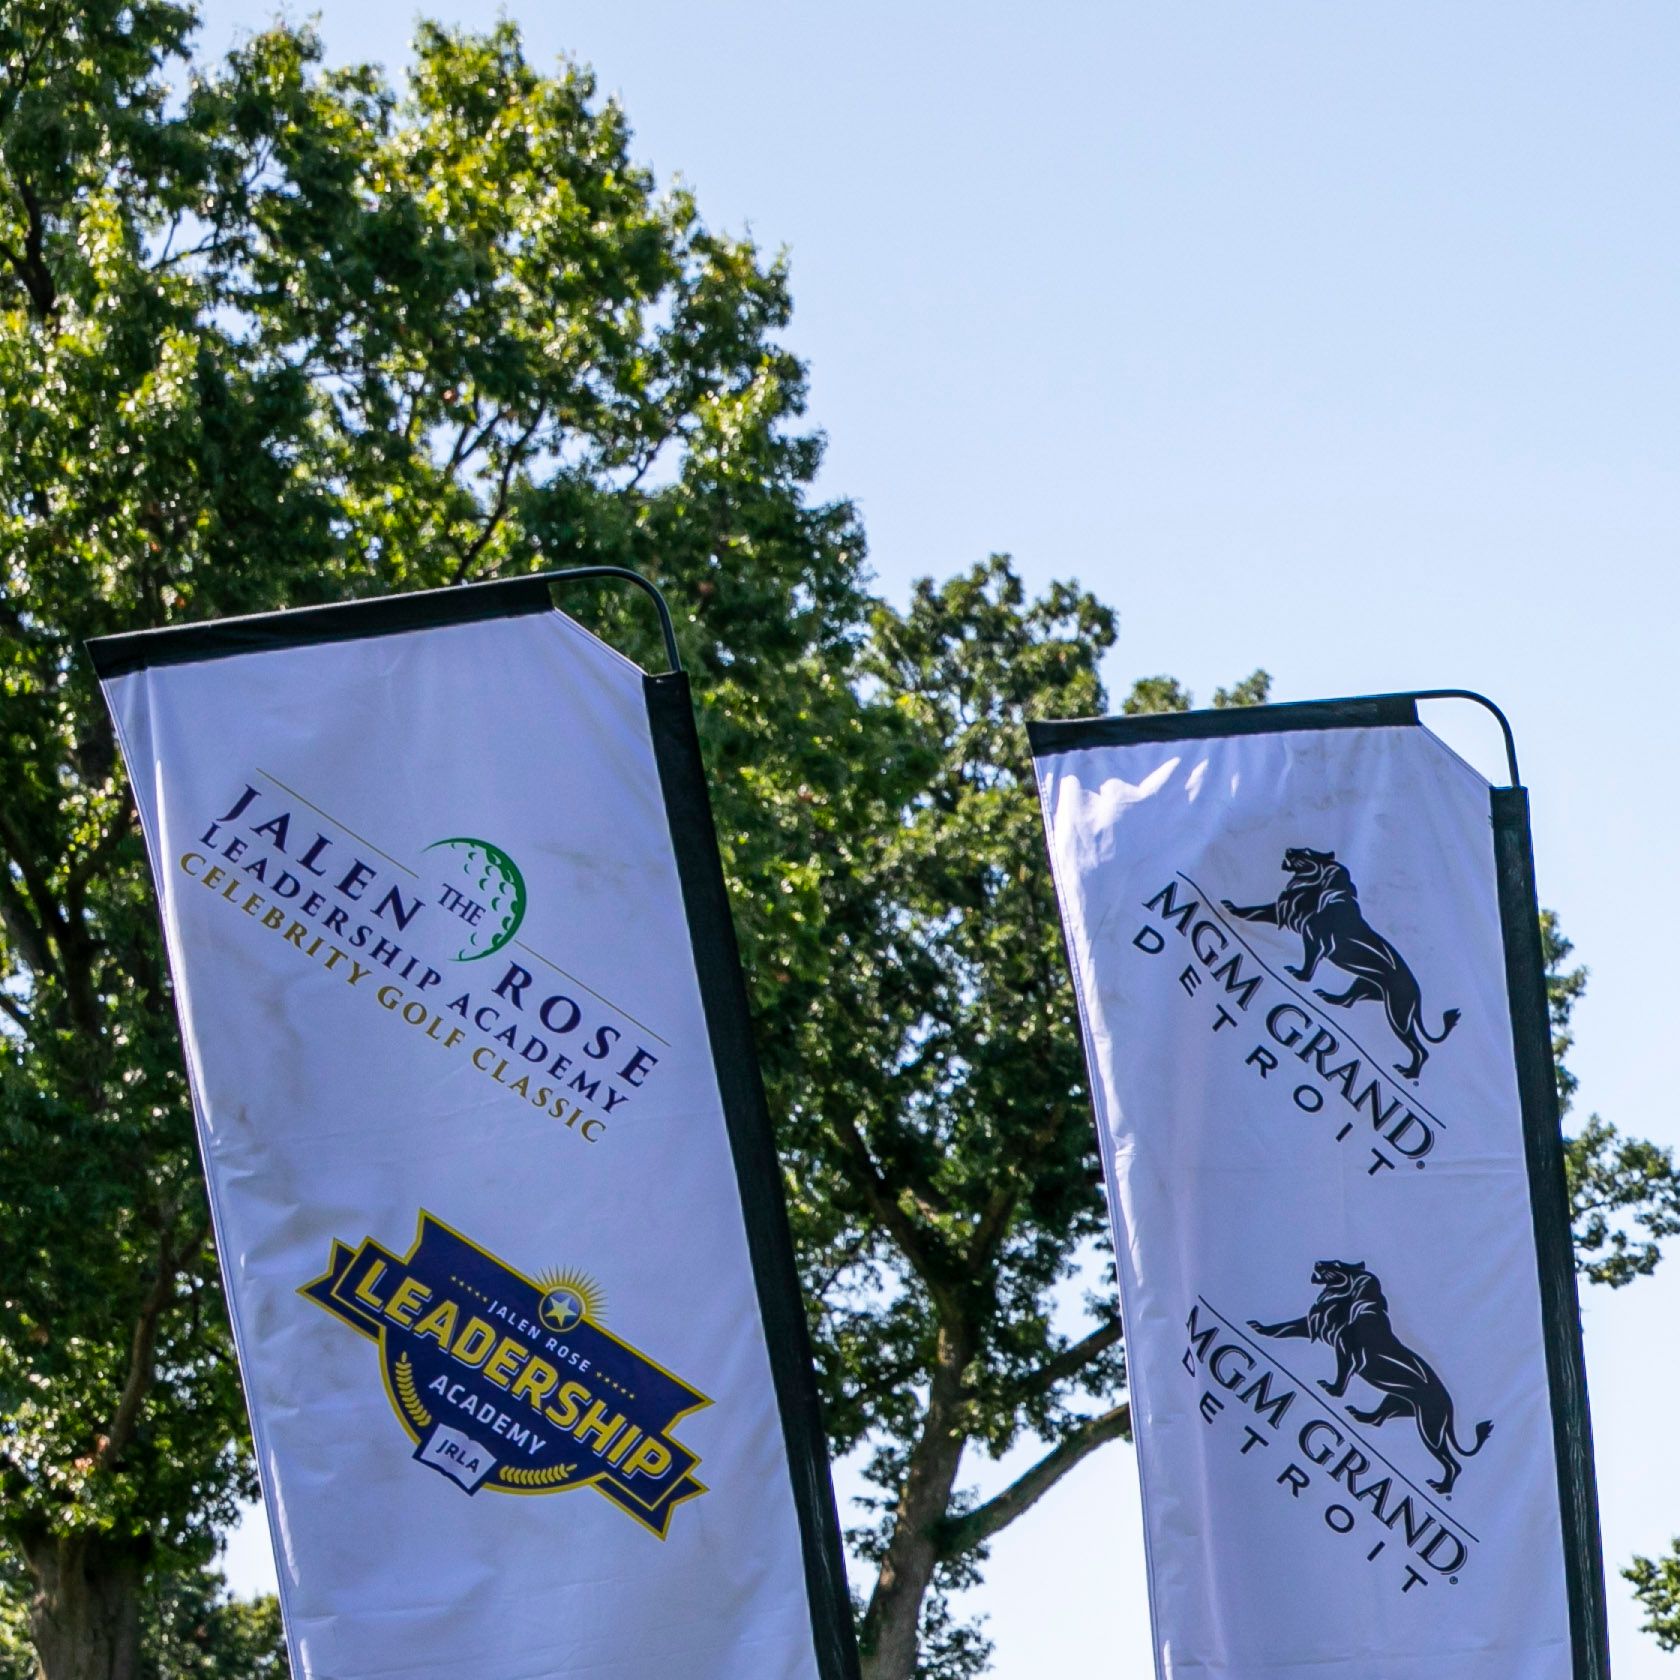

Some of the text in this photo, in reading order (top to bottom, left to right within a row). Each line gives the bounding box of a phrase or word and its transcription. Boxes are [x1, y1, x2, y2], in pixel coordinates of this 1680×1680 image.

[178, 851, 606, 1144] CELEBRITY GOLF CLASSIC
[199, 821, 630, 1115] LEADERSHIP ACADEMY
[215, 784, 659, 1090] JALEN THE ROSE
[1132, 924, 1395, 1177] DETROIT
[1144, 879, 1266, 1012] MGM
[355, 1256, 672, 1483] LEADERSHIP
[428, 1373, 547, 1457] ACADEMY
[489, 1299, 591, 1373] JALEN ROSE
[1185, 1303, 1298, 1429] MGM
[435, 1437, 479, 1476] JRLA
[1182, 1348, 1428, 1594] DETROIT
